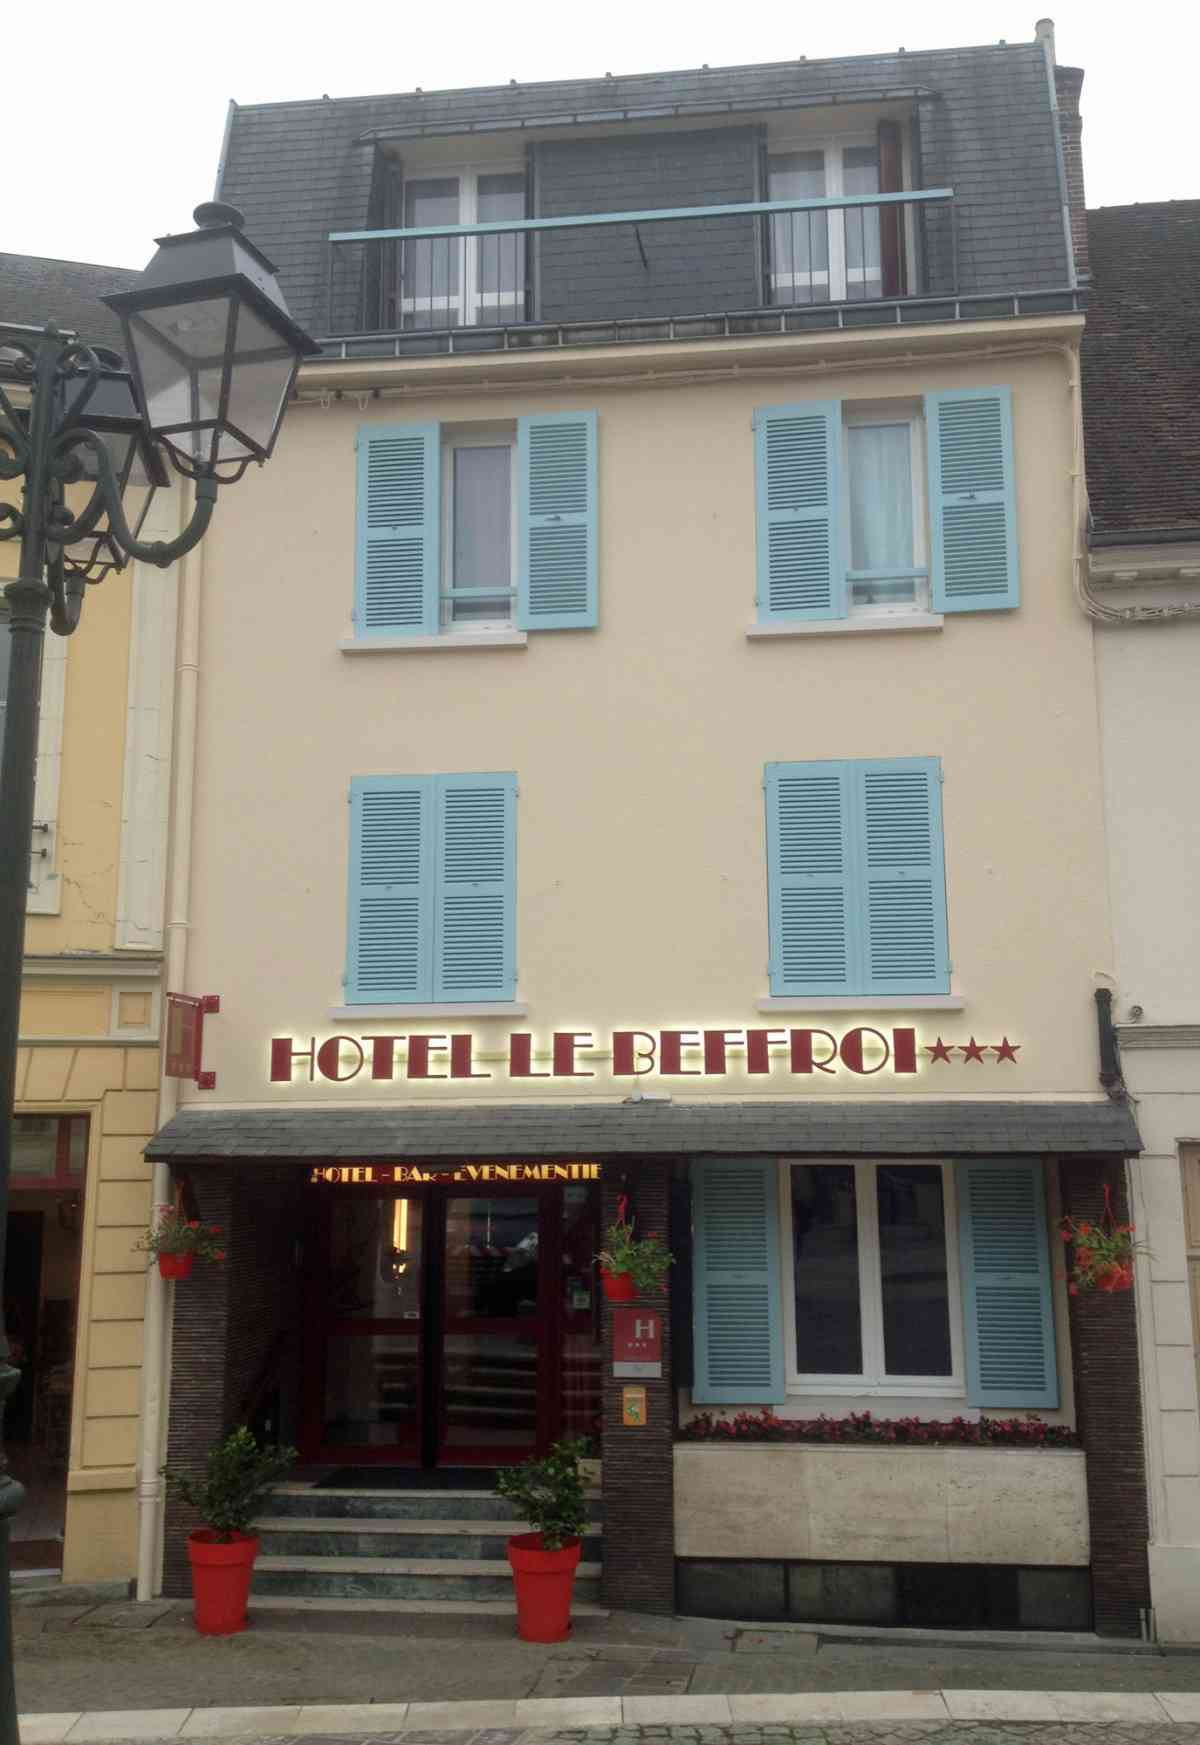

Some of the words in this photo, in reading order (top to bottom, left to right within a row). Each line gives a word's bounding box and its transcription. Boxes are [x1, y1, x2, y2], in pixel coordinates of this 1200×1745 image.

[270, 1032, 491, 1082] HOTEL
[510, 1031, 594, 1078] LE
[612, 1027, 917, 1076] BEFFROI
[310, 1166, 378, 1183] HOTEL
[634, 1319, 655, 1339] H
